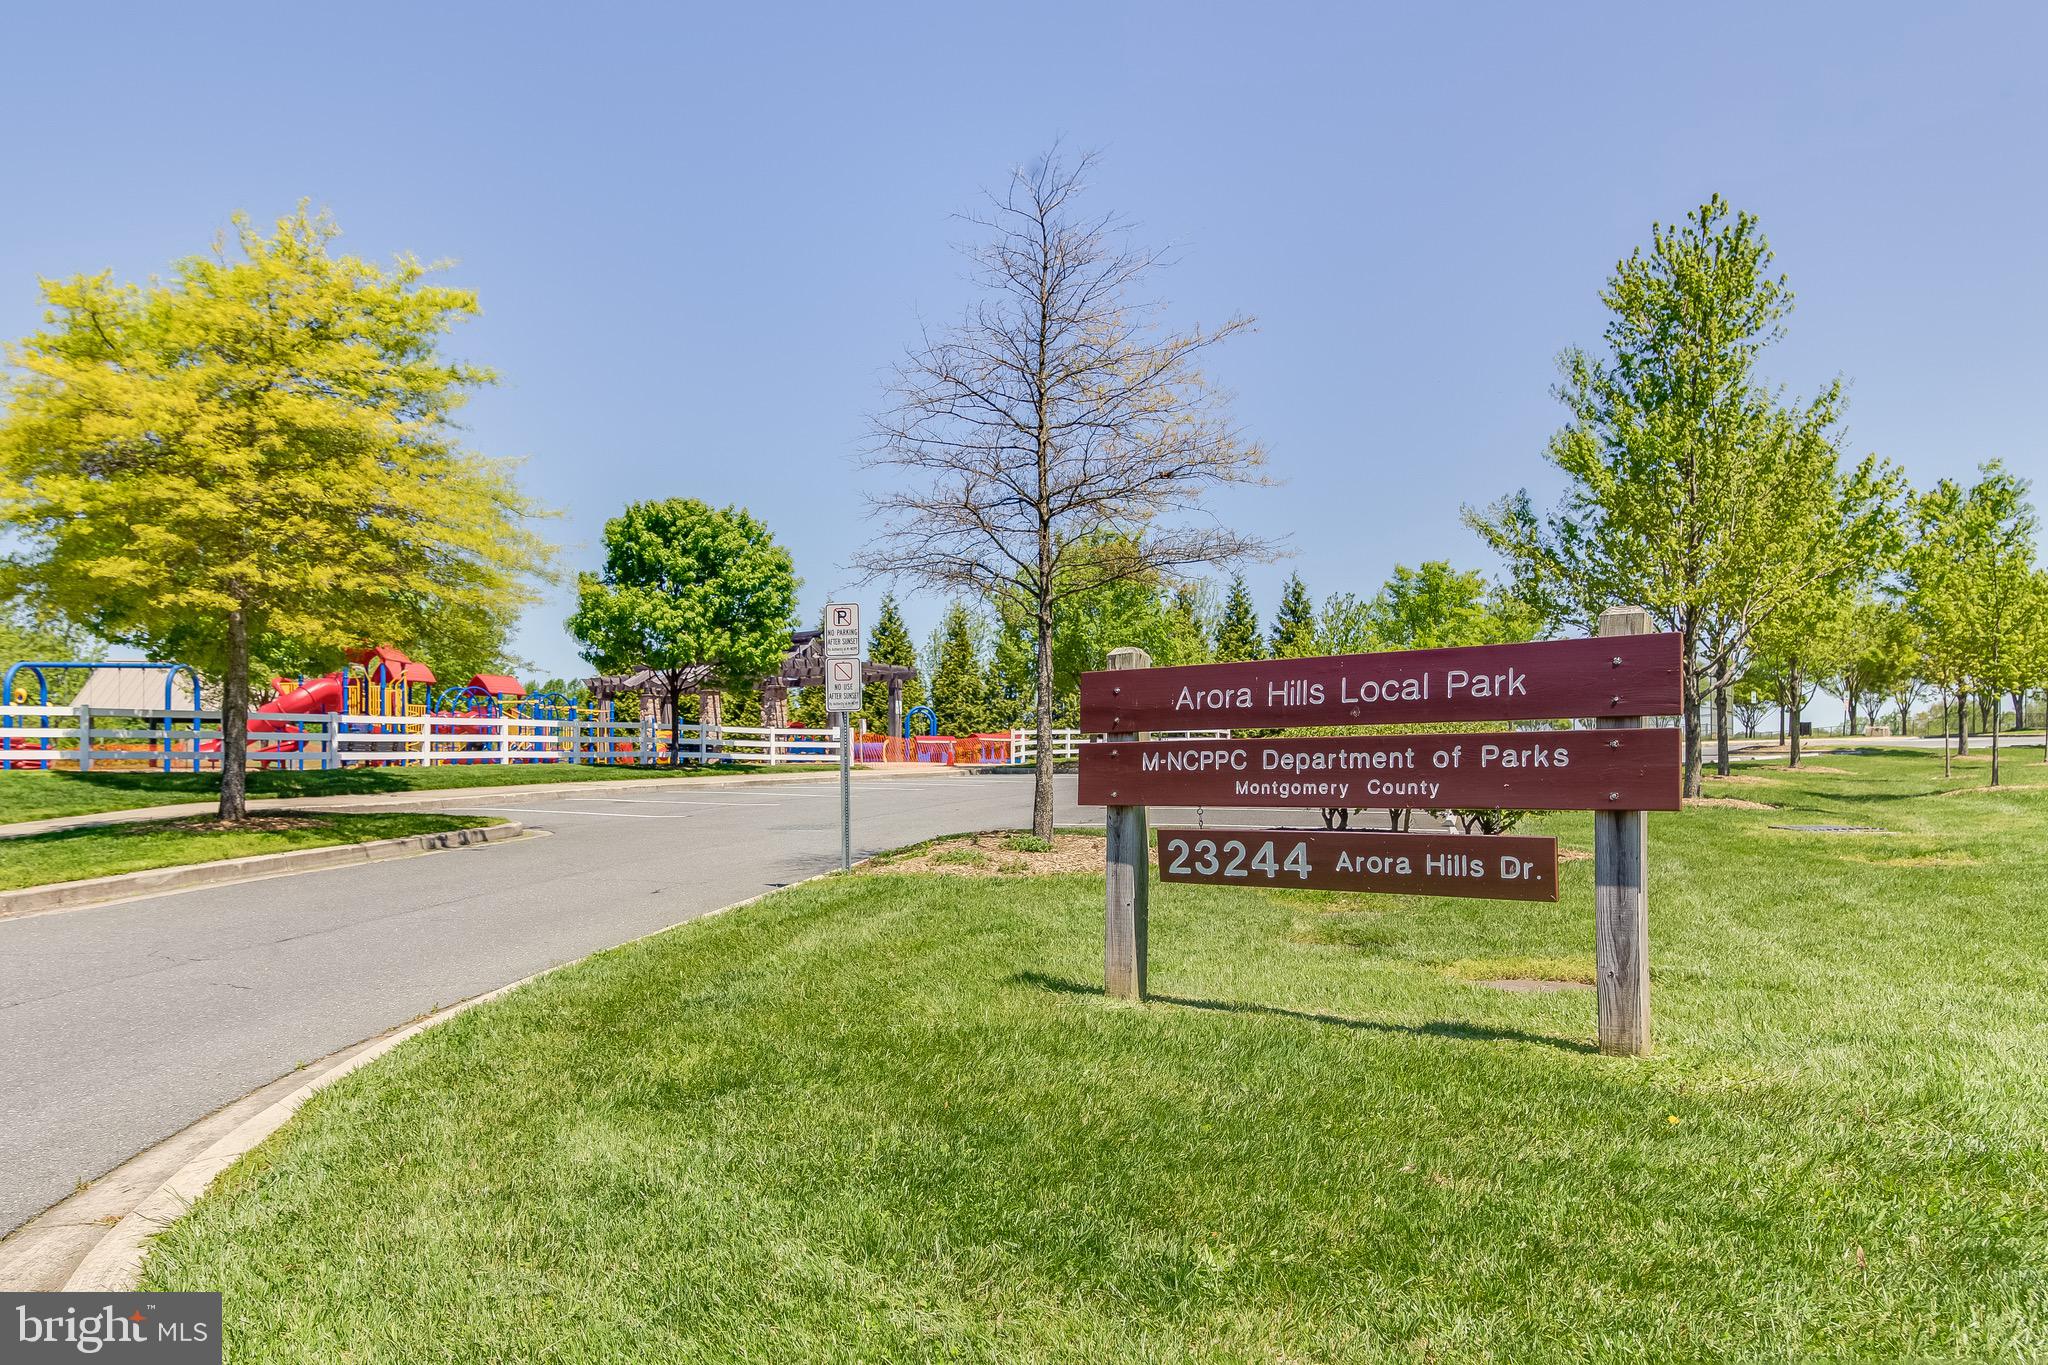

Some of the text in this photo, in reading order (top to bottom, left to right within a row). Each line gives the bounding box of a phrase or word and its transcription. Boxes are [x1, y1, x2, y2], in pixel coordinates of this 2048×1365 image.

[1175, 667, 1527, 711] Arora Hills Local Park
[1142, 745, 1570, 773] M-NCPPC Department of Parks
[1235, 779, 1439, 798] Montgomery County
[1167, 838, 1542, 881] 23244 Arora Hills Dr.
